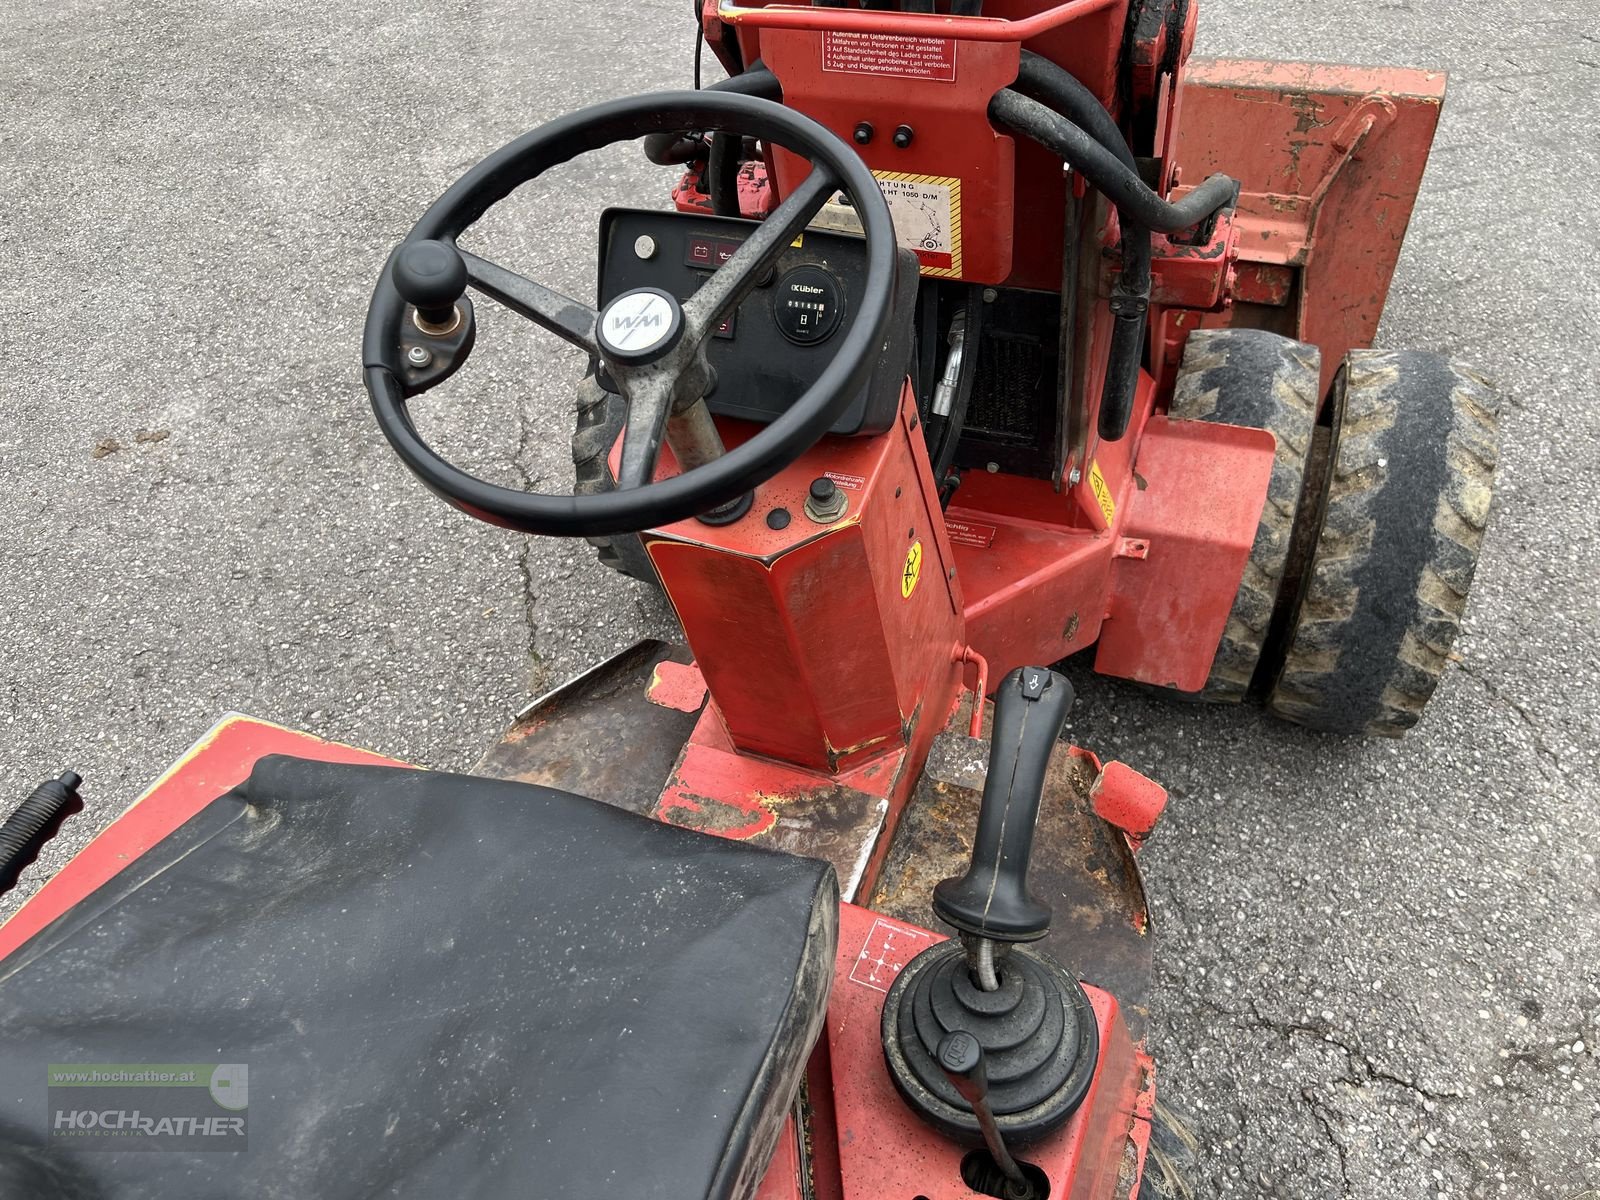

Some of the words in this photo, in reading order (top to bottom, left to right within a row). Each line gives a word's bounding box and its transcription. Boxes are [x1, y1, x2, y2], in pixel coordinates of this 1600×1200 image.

[832, 31, 860, 39] Aufenthalt
[832, 38, 859, 46] Mitfahren
[843, 47, 887, 56] Standsicherheit
[832, 53, 860, 61] Aufenthalt
[878, 56, 909, 66] gehobener
[909, 59, 923, 67] Last
[832, 61, 846, 69] Zug-
[860, 63, 904, 73] Rangierarbeiten
[922, 193, 938, 201] D/M
[790, 284, 824, 294] Kübler
